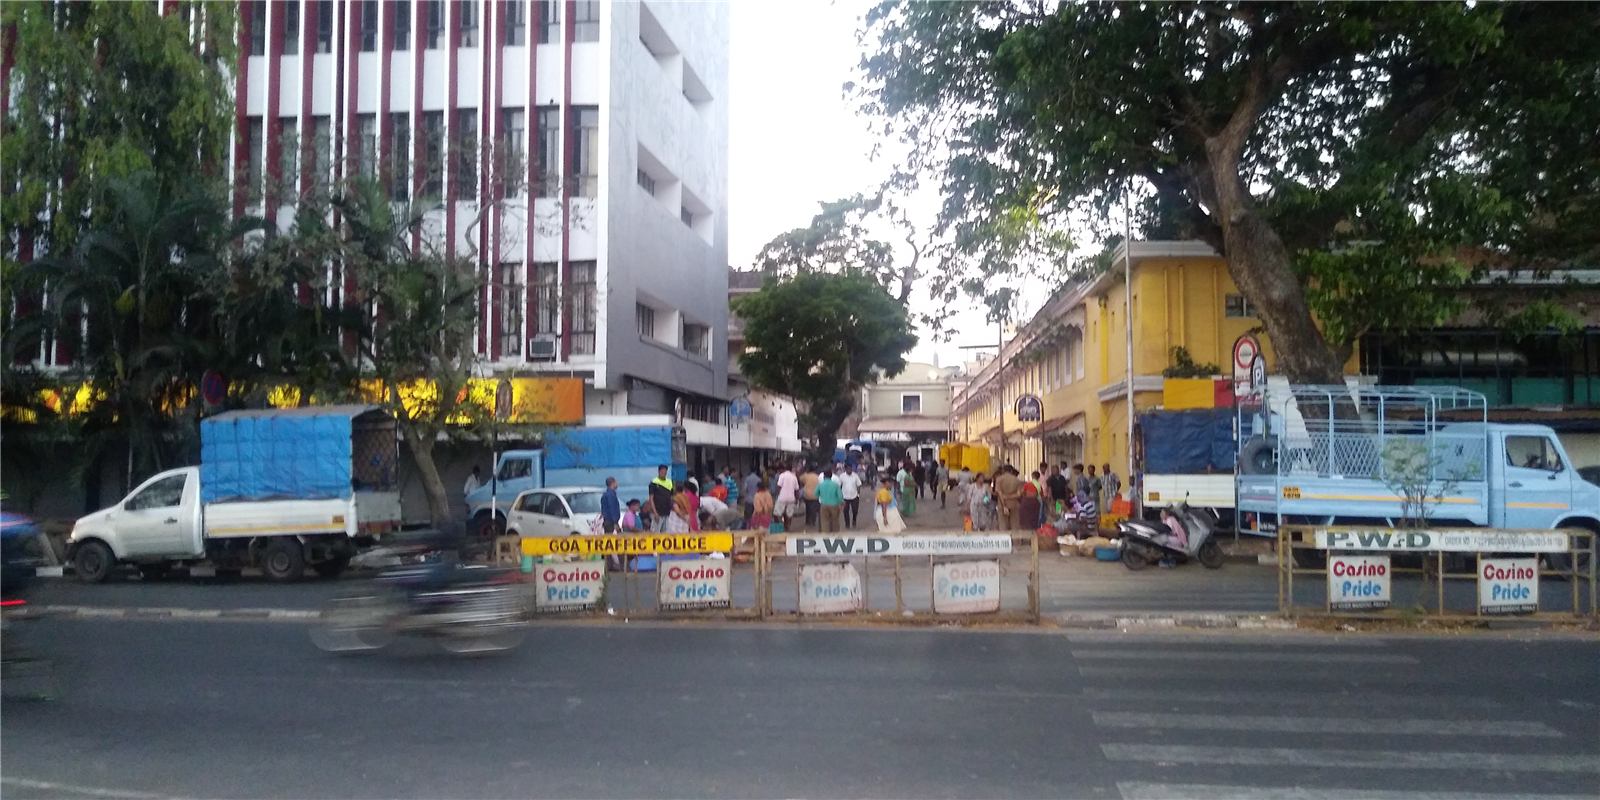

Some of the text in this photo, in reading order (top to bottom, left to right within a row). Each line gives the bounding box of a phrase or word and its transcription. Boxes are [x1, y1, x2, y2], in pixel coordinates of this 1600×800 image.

[549, 536, 707, 552] GOA TRAFFIC POLICE
[796, 538, 890, 553] P.W.D
[543, 567, 601, 582] Casino
[668, 565, 724, 580] Casino
[951, 563, 997, 580] Casino
[1333, 560, 1385, 577] Casino
[1484, 563, 1533, 580] Casino
[548, 585, 590, 600] Pride
[675, 583, 717, 598] Pride
[815, 584, 849, 598] Pride
[951, 582, 986, 597] Pride
[1342, 580, 1382, 596] Pride
[1492, 583, 1530, 600] Pride
